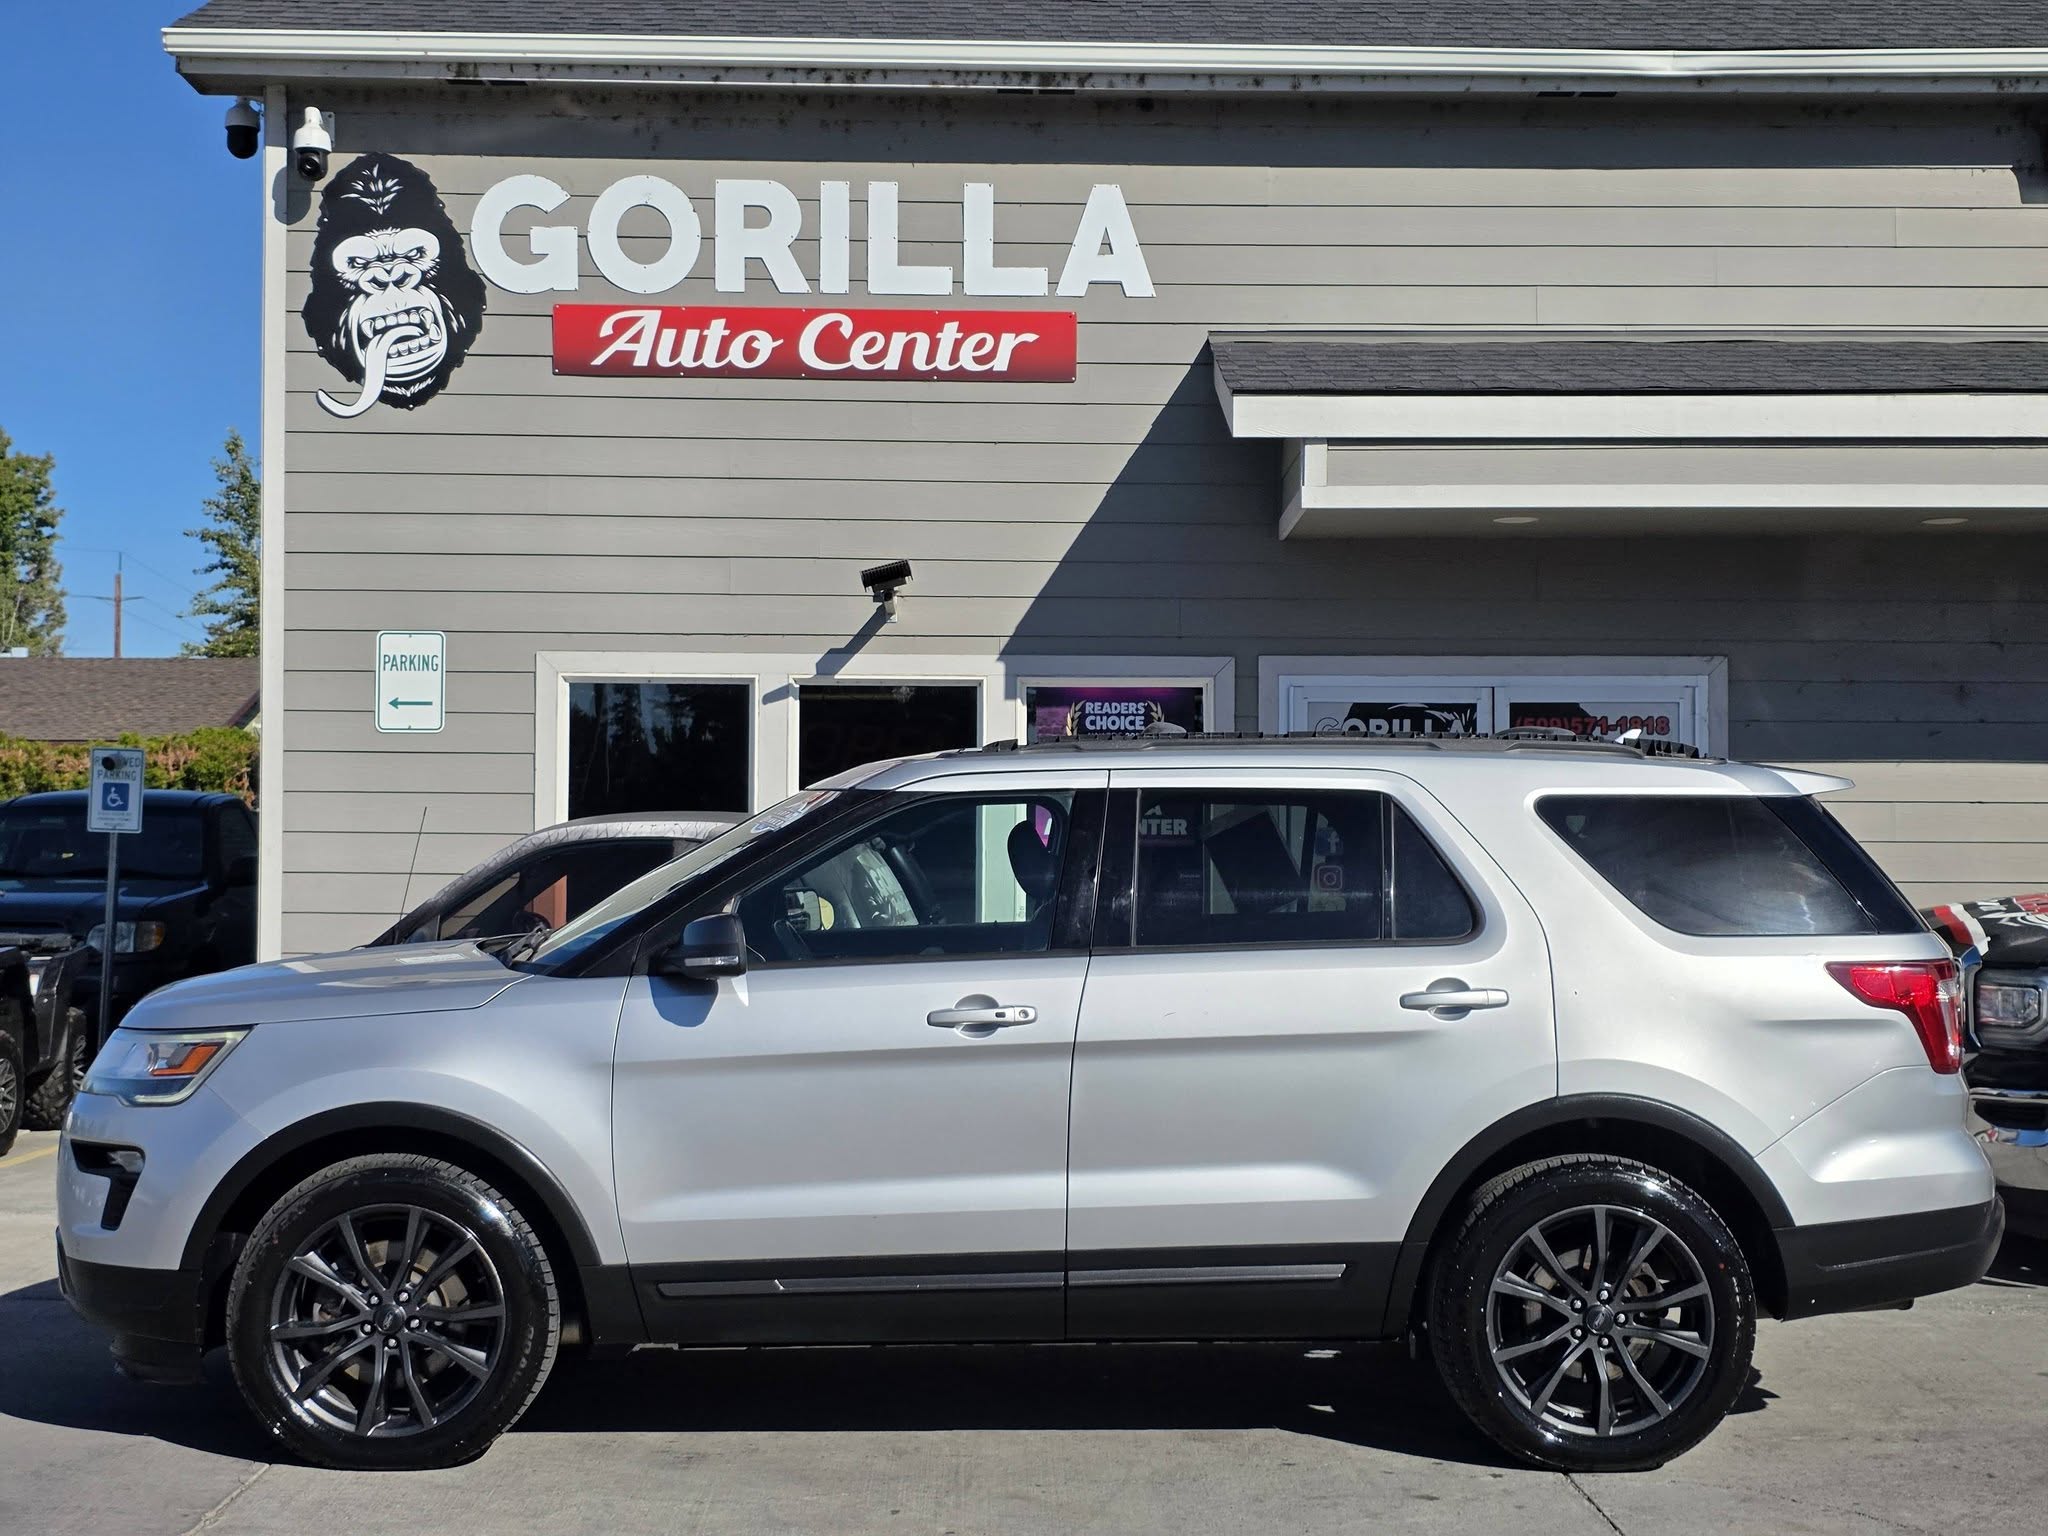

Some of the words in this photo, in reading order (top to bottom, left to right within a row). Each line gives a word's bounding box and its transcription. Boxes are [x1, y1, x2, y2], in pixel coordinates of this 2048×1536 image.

[470, 174, 1157, 298] GORILLA
[590, 309, 784, 369] Auto
[799, 312, 1040, 372] Center
[383, 654, 439, 672] PARKING
[1085, 715, 1146, 731] CHOICE
[97, 769, 137, 781] PARKING
